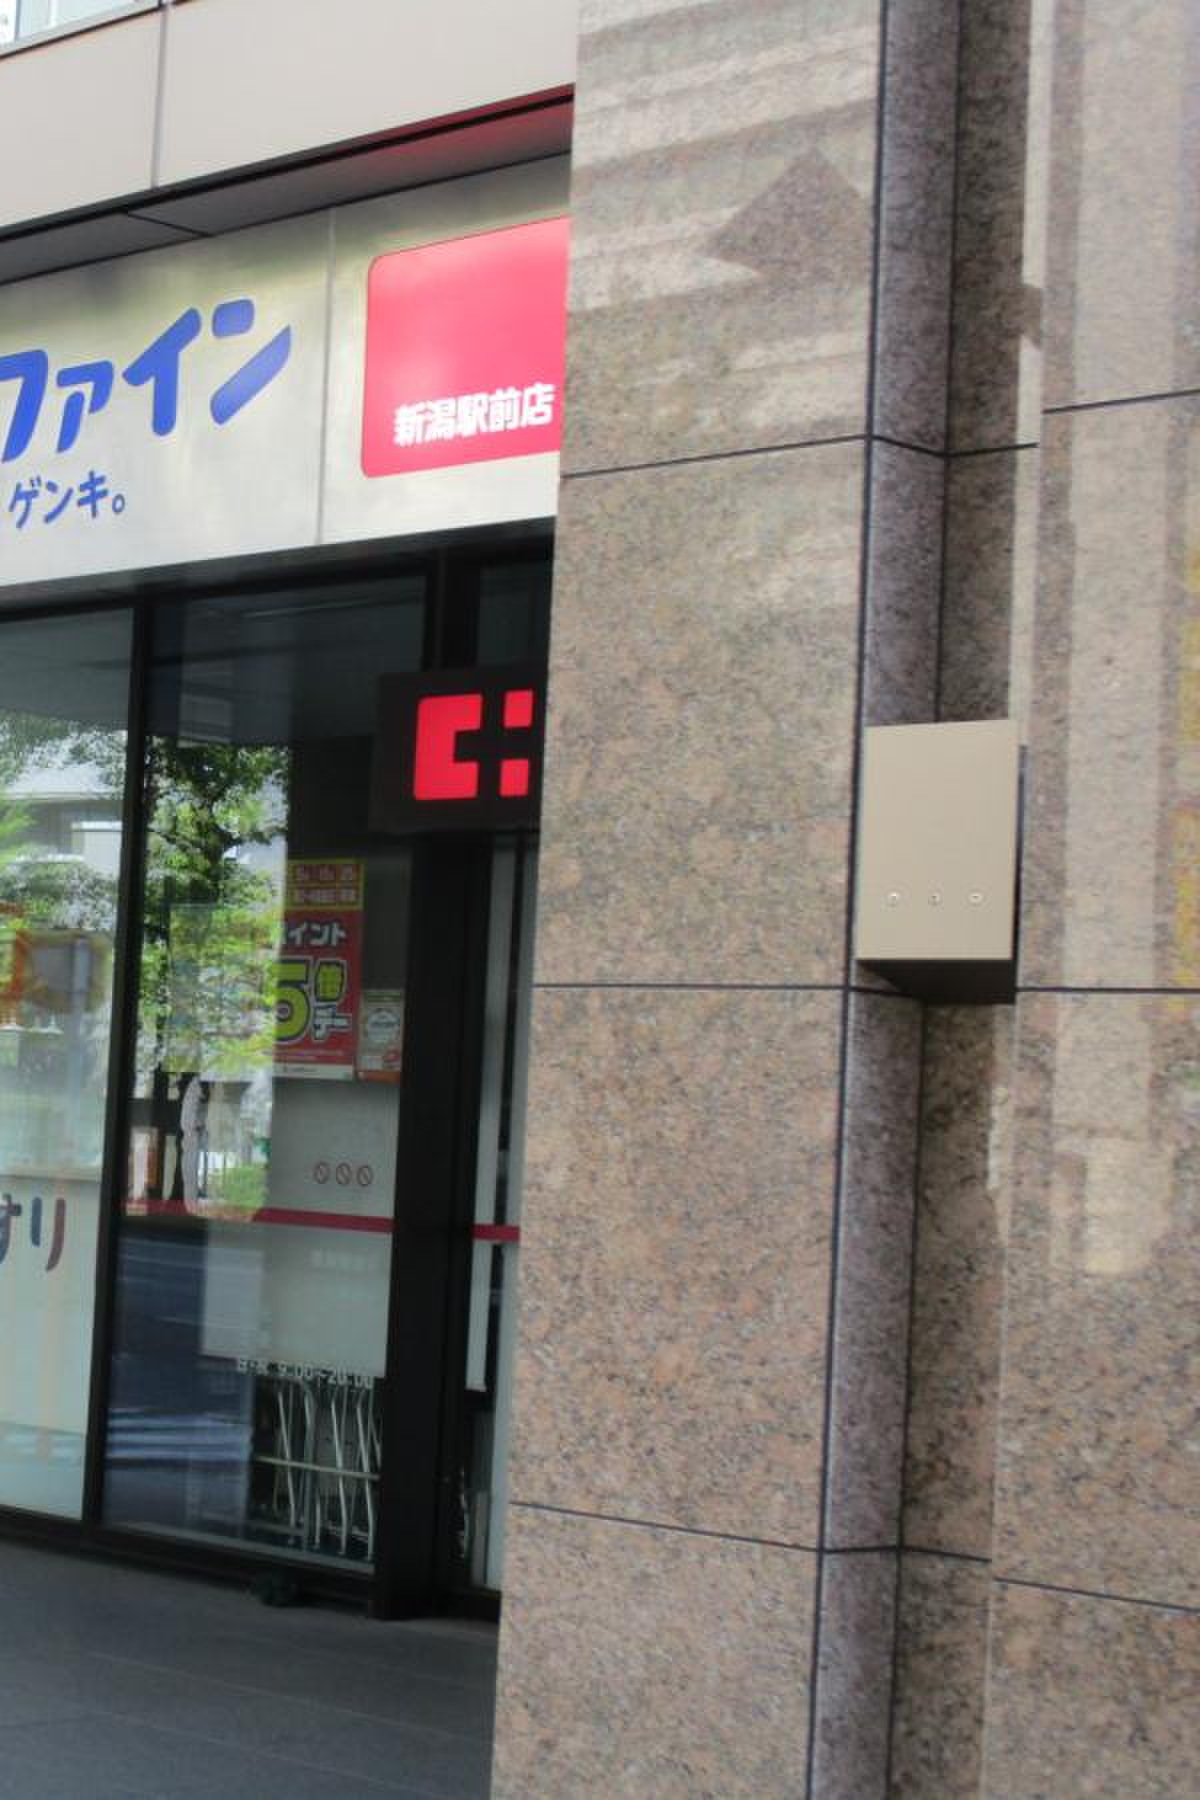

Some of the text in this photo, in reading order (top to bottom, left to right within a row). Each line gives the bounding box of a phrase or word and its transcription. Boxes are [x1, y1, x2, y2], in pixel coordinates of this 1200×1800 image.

[393, 382, 555, 446] 新潟駅前店
